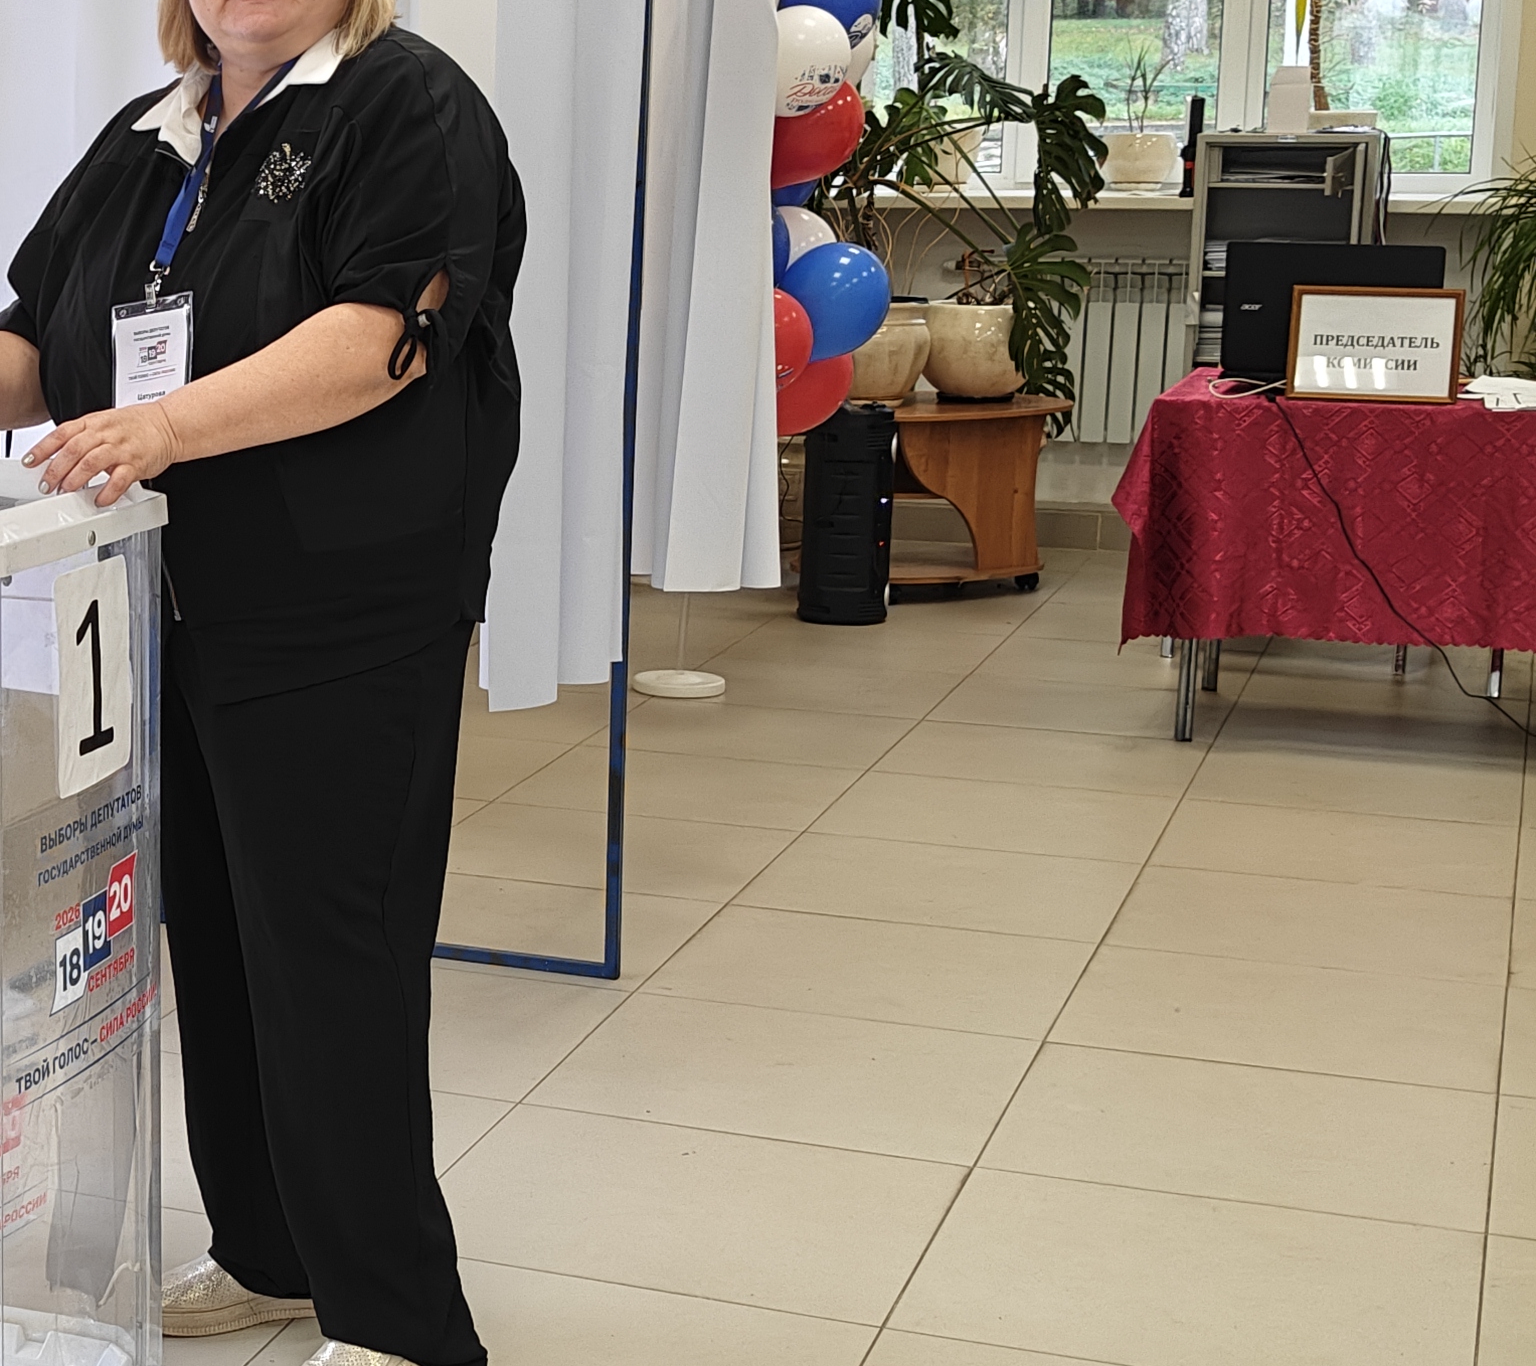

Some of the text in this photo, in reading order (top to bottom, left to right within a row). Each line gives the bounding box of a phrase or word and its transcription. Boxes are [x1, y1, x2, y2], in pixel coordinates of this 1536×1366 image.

[1240, 303, 1263, 311] acer
[1312, 333, 1441, 349] ПРЕДСЕДАТЕЛЬ
[1326, 357, 1418, 371] КОМИСИИ
[76, 599, 115, 757] 1
[40, 784, 142, 854] ВЫБОРЫ ДЕПУТАТОВ
[37, 815, 144, 887] ГОСУДАРСТВЕННОЙ ДУМЫ
[55, 902, 80, 931] 2026
[59, 874, 132, 992] 18 19 20
[87, 947, 135, 993] СЕНТЯБРЯ
[15, 1057, 50, 1095] ТВОЙ
[52, 1037, 89, 1075] ГОЛОС
[99, 1012, 124, 1043] СИЛА
